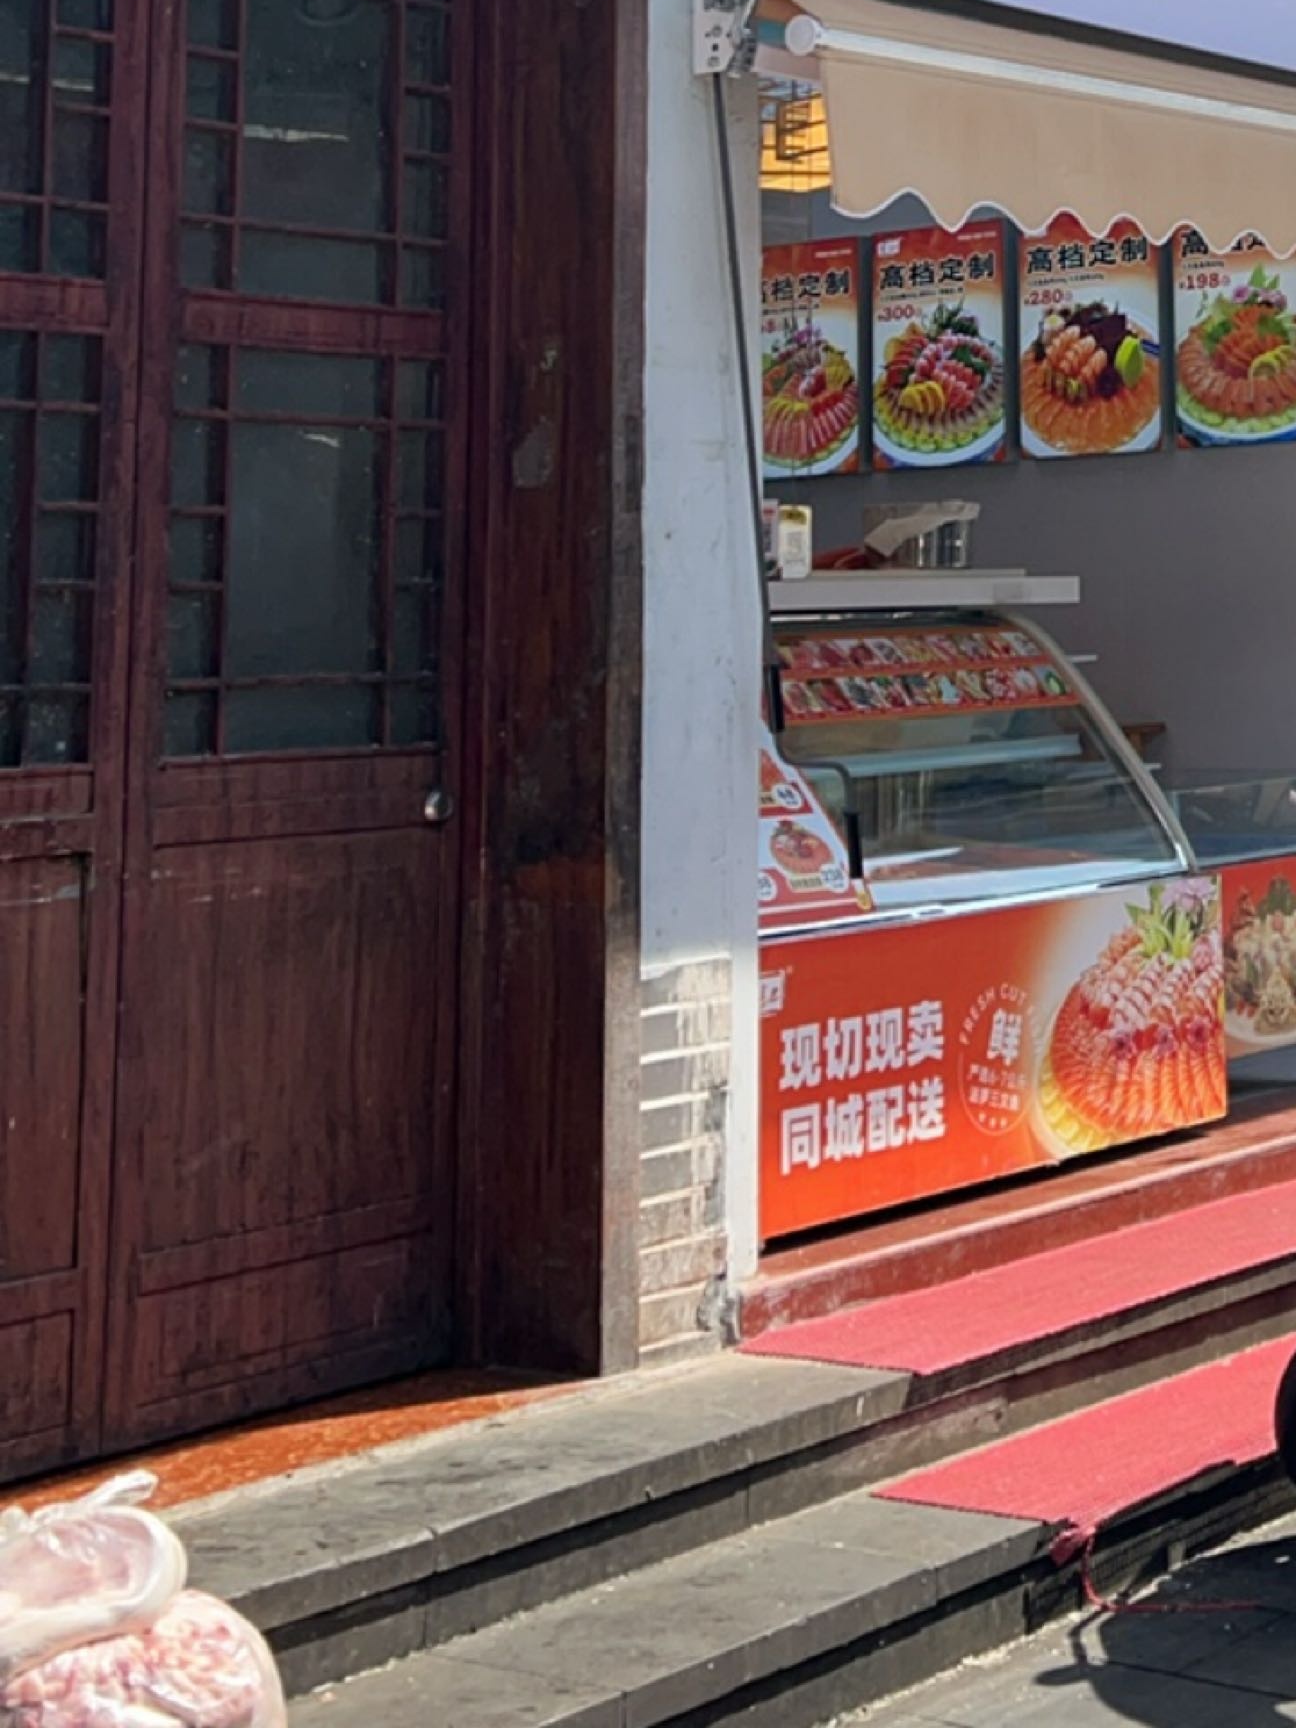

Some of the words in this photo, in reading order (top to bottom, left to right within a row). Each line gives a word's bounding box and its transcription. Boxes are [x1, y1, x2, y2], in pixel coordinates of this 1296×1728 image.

[879, 251, 995, 290] 高档定制
[1027, 235, 1148, 274] 高档定制
[779, 1000, 944, 1092] 现切现卖
[986, 1007, 1023, 1067] 鲜
[779, 1076, 946, 1177] 同城配送
